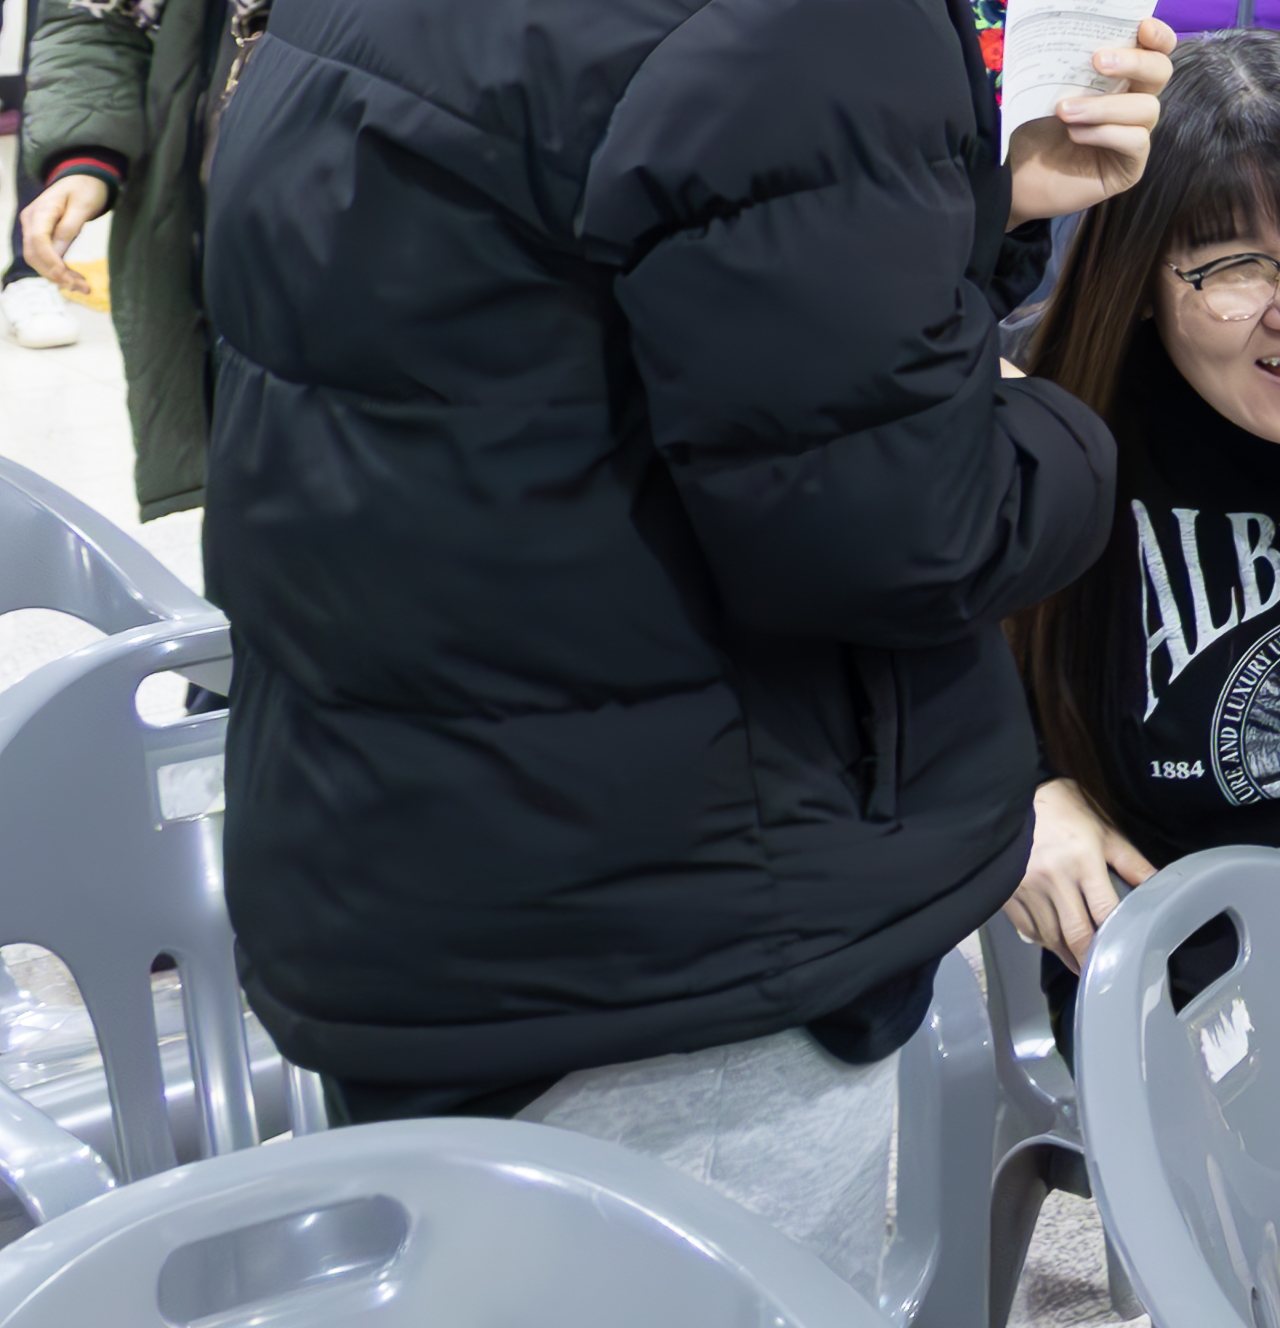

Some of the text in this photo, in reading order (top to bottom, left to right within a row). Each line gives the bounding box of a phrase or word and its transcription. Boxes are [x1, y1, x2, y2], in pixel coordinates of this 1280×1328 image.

[1223, 650, 1272, 723] LUXURY
[1219, 727, 1240, 763] AND
[1149, 759, 1206, 781] 1884
